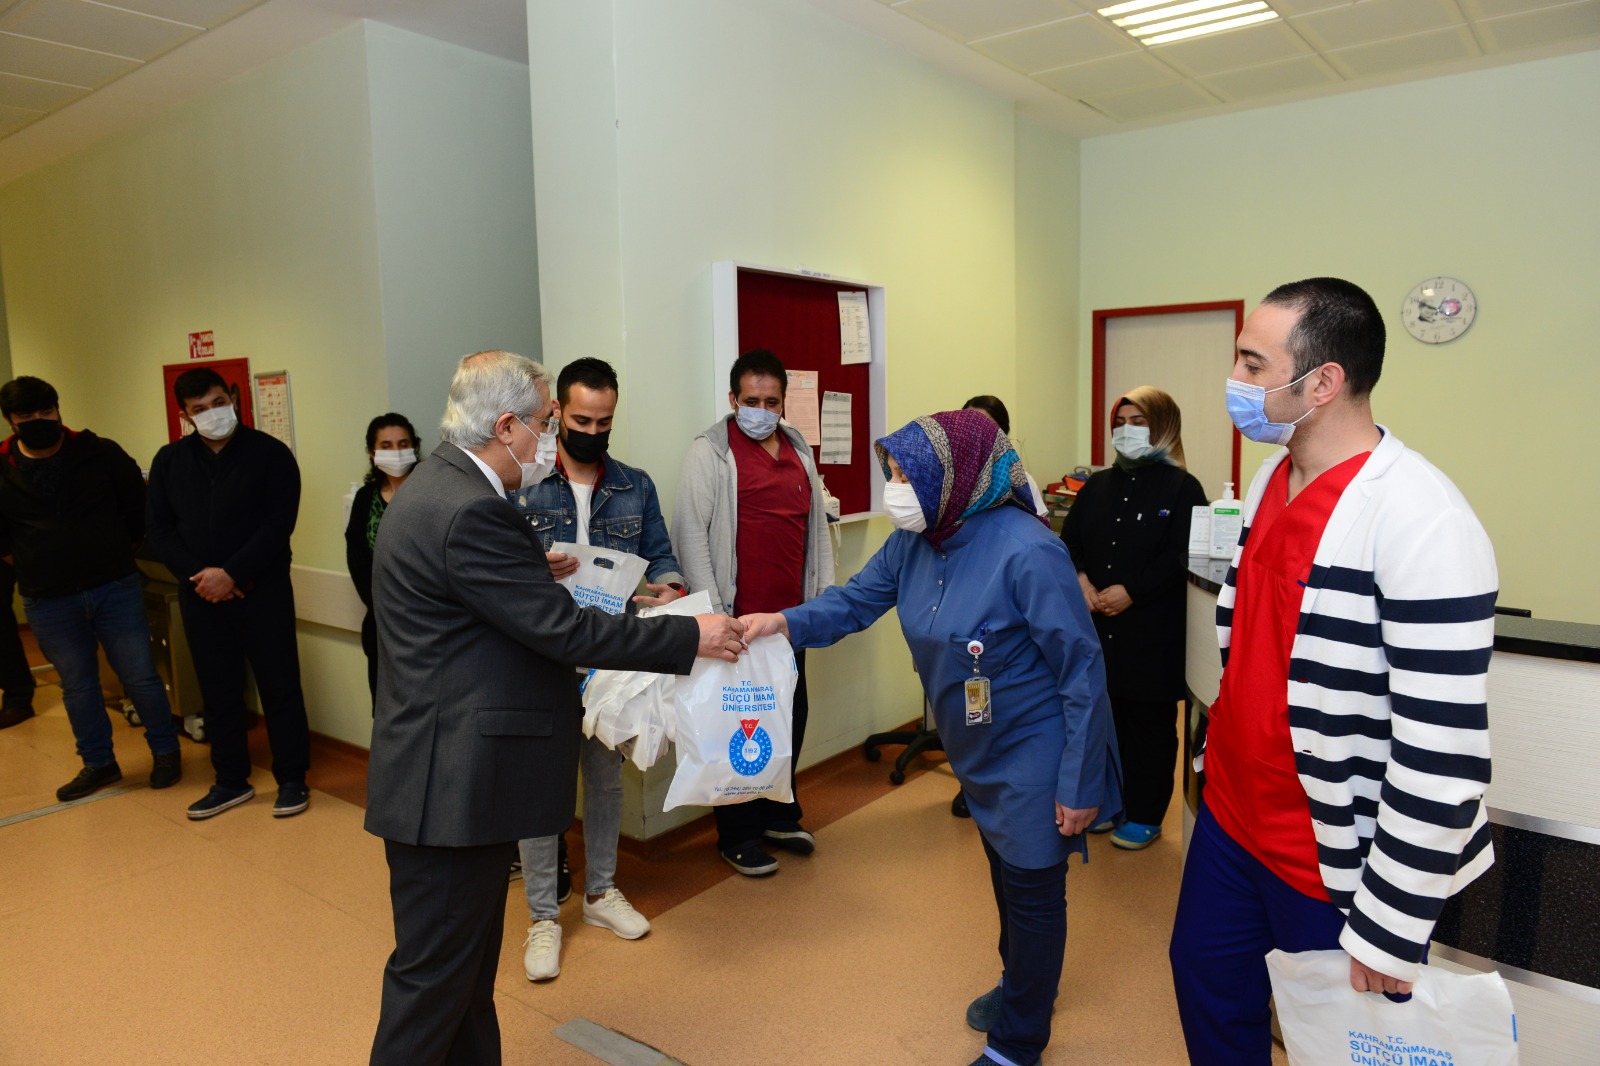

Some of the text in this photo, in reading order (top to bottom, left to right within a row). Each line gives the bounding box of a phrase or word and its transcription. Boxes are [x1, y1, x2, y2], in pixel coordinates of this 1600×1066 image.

[574, 590, 623, 608] SÜTÇÜ İMAM
[1349, 1030, 1452, 1060] KAHRAMANMARAŞ
[1386, 1035, 1407, 1044] T.C.
[1350, 1040, 1403, 1065] SÜTÇÜ
